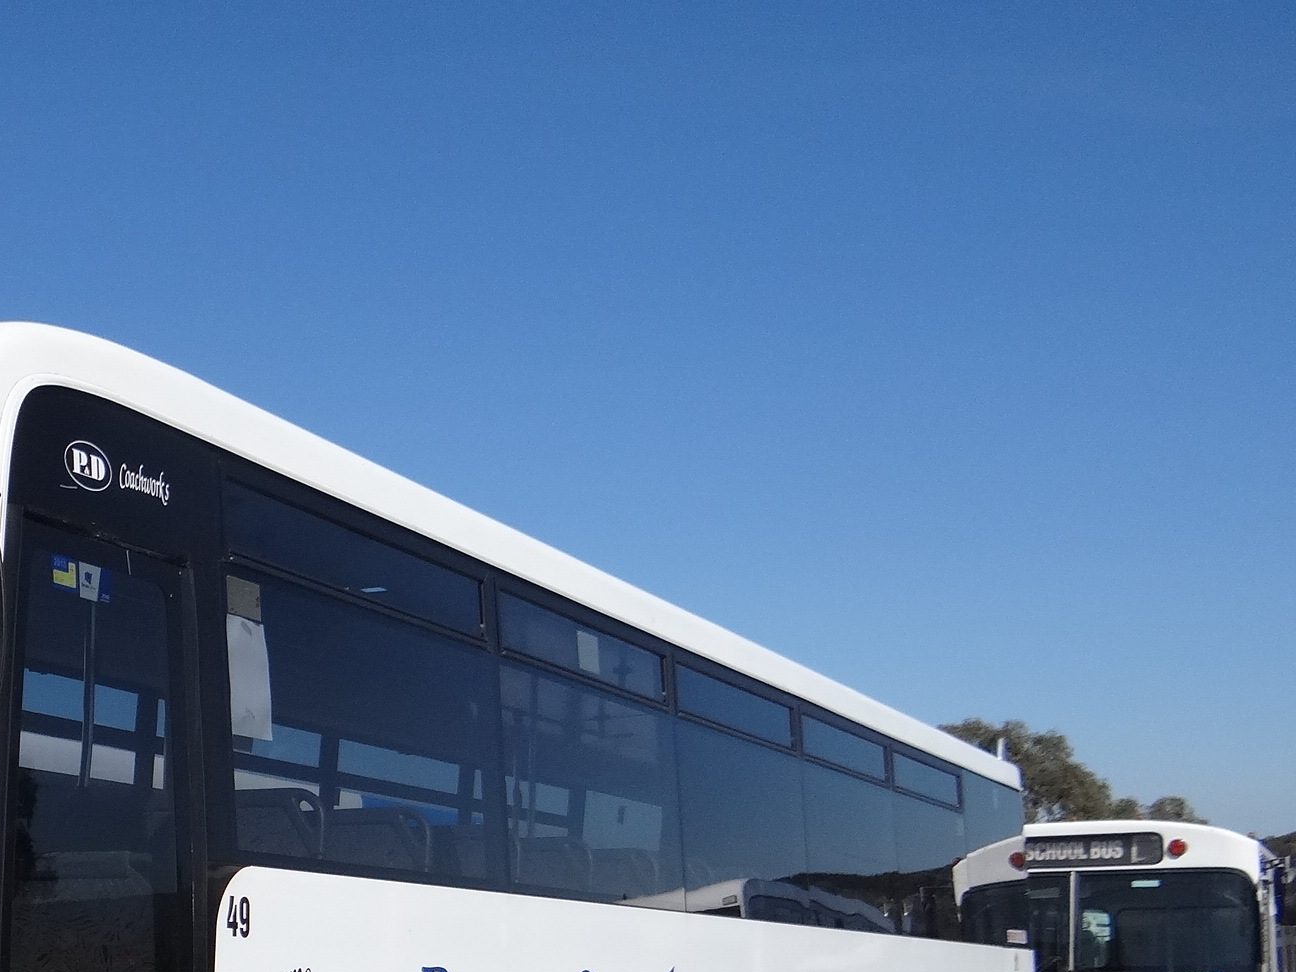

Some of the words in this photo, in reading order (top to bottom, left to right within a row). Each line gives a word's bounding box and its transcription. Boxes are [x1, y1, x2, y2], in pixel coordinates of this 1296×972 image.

[119, 463, 170, 506] Coachworks
[1025, 841, 1088, 861] SCHOOL
[1089, 839, 1124, 860] BUS
[226, 895, 251, 938] 49
